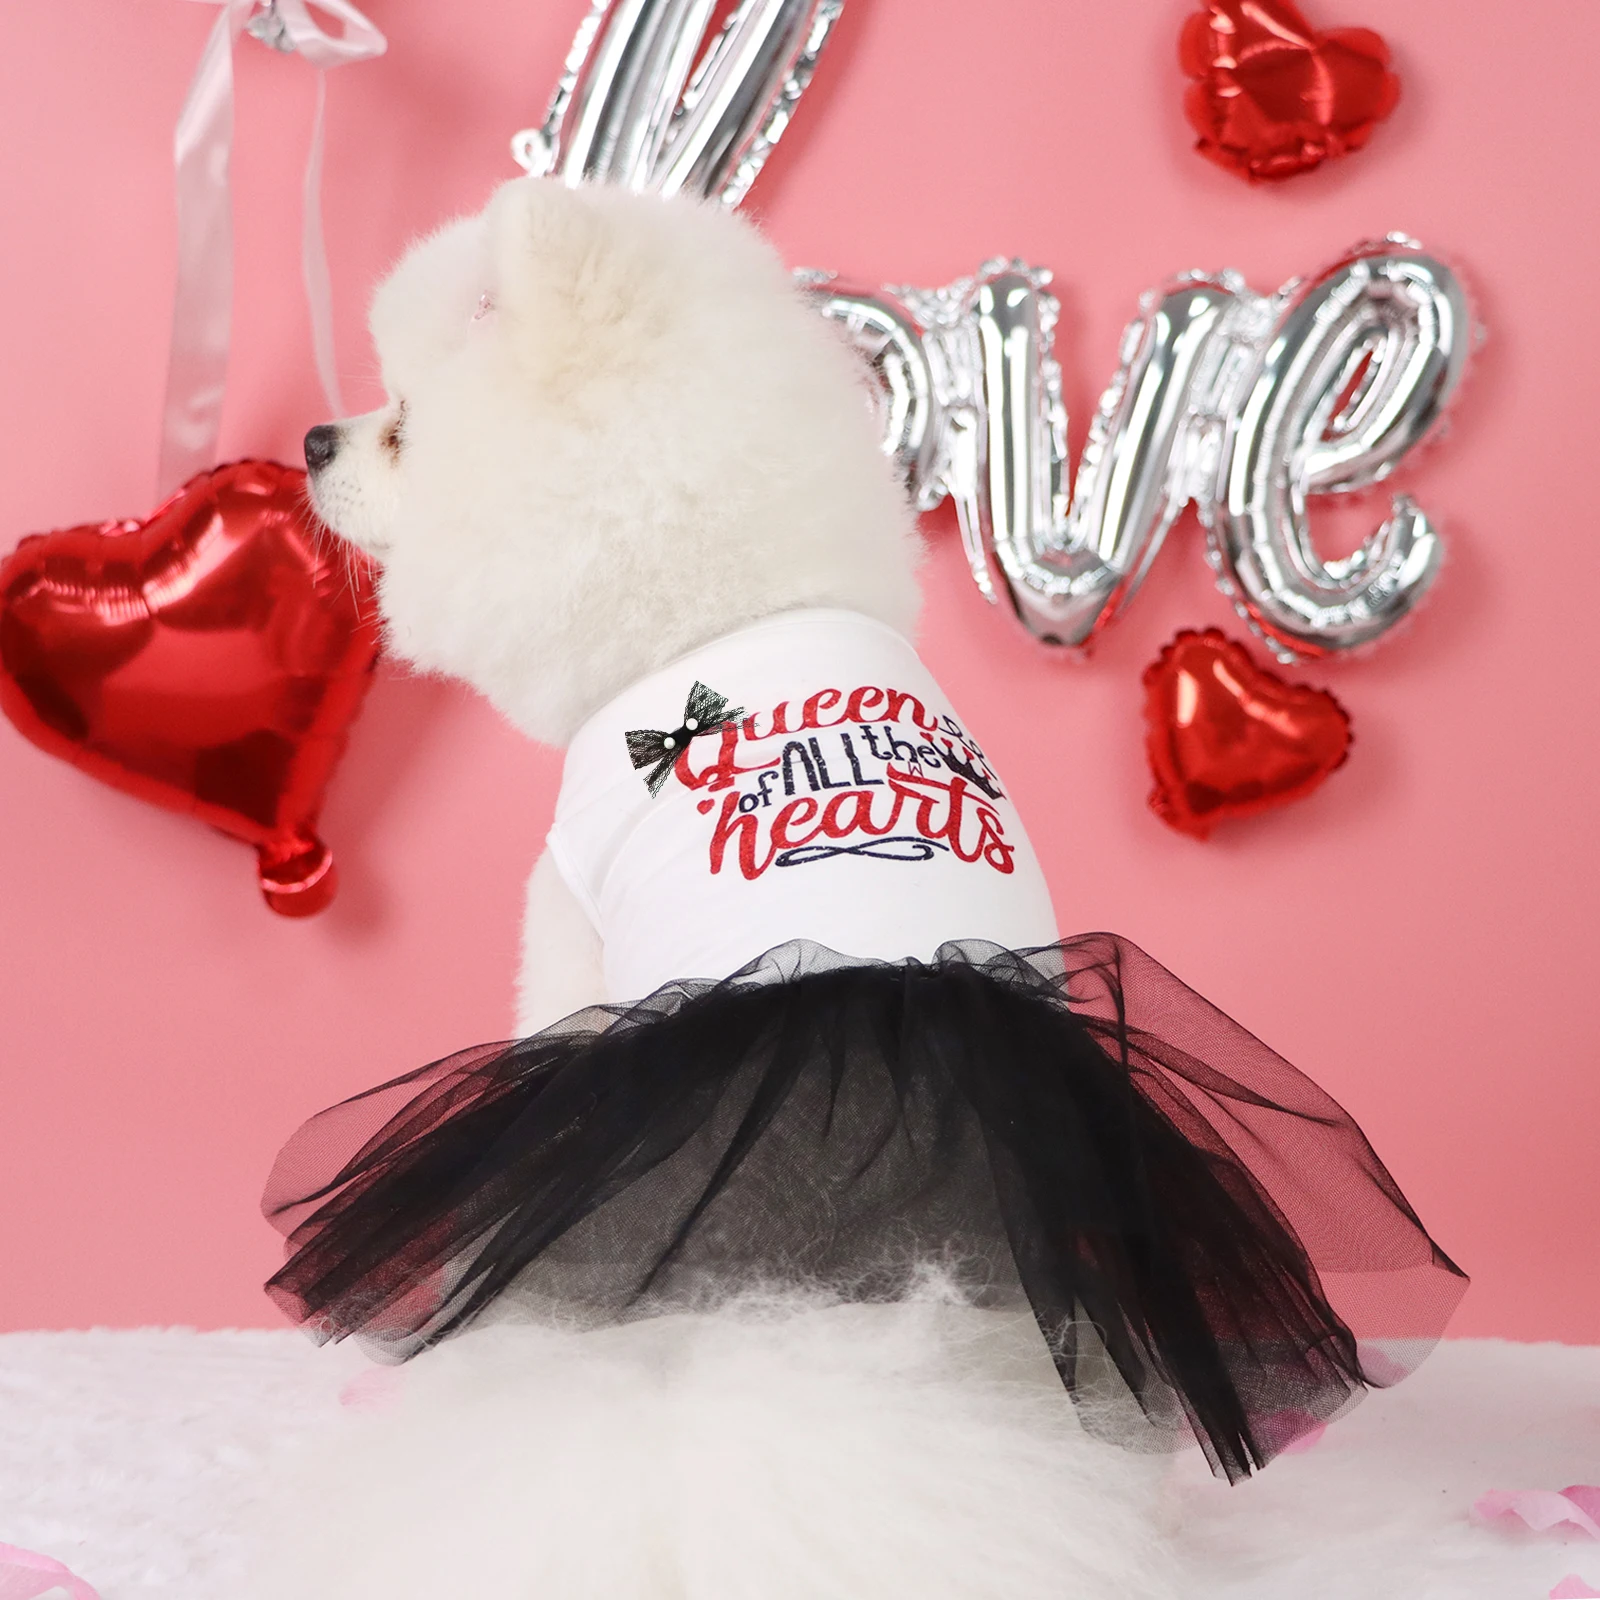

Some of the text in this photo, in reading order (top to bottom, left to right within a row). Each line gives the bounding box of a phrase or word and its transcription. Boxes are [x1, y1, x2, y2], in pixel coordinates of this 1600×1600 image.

[674, 685, 939, 791] Queen
[739, 725, 942, 813] of ALL the
[709, 765, 1014, 880] hearts
